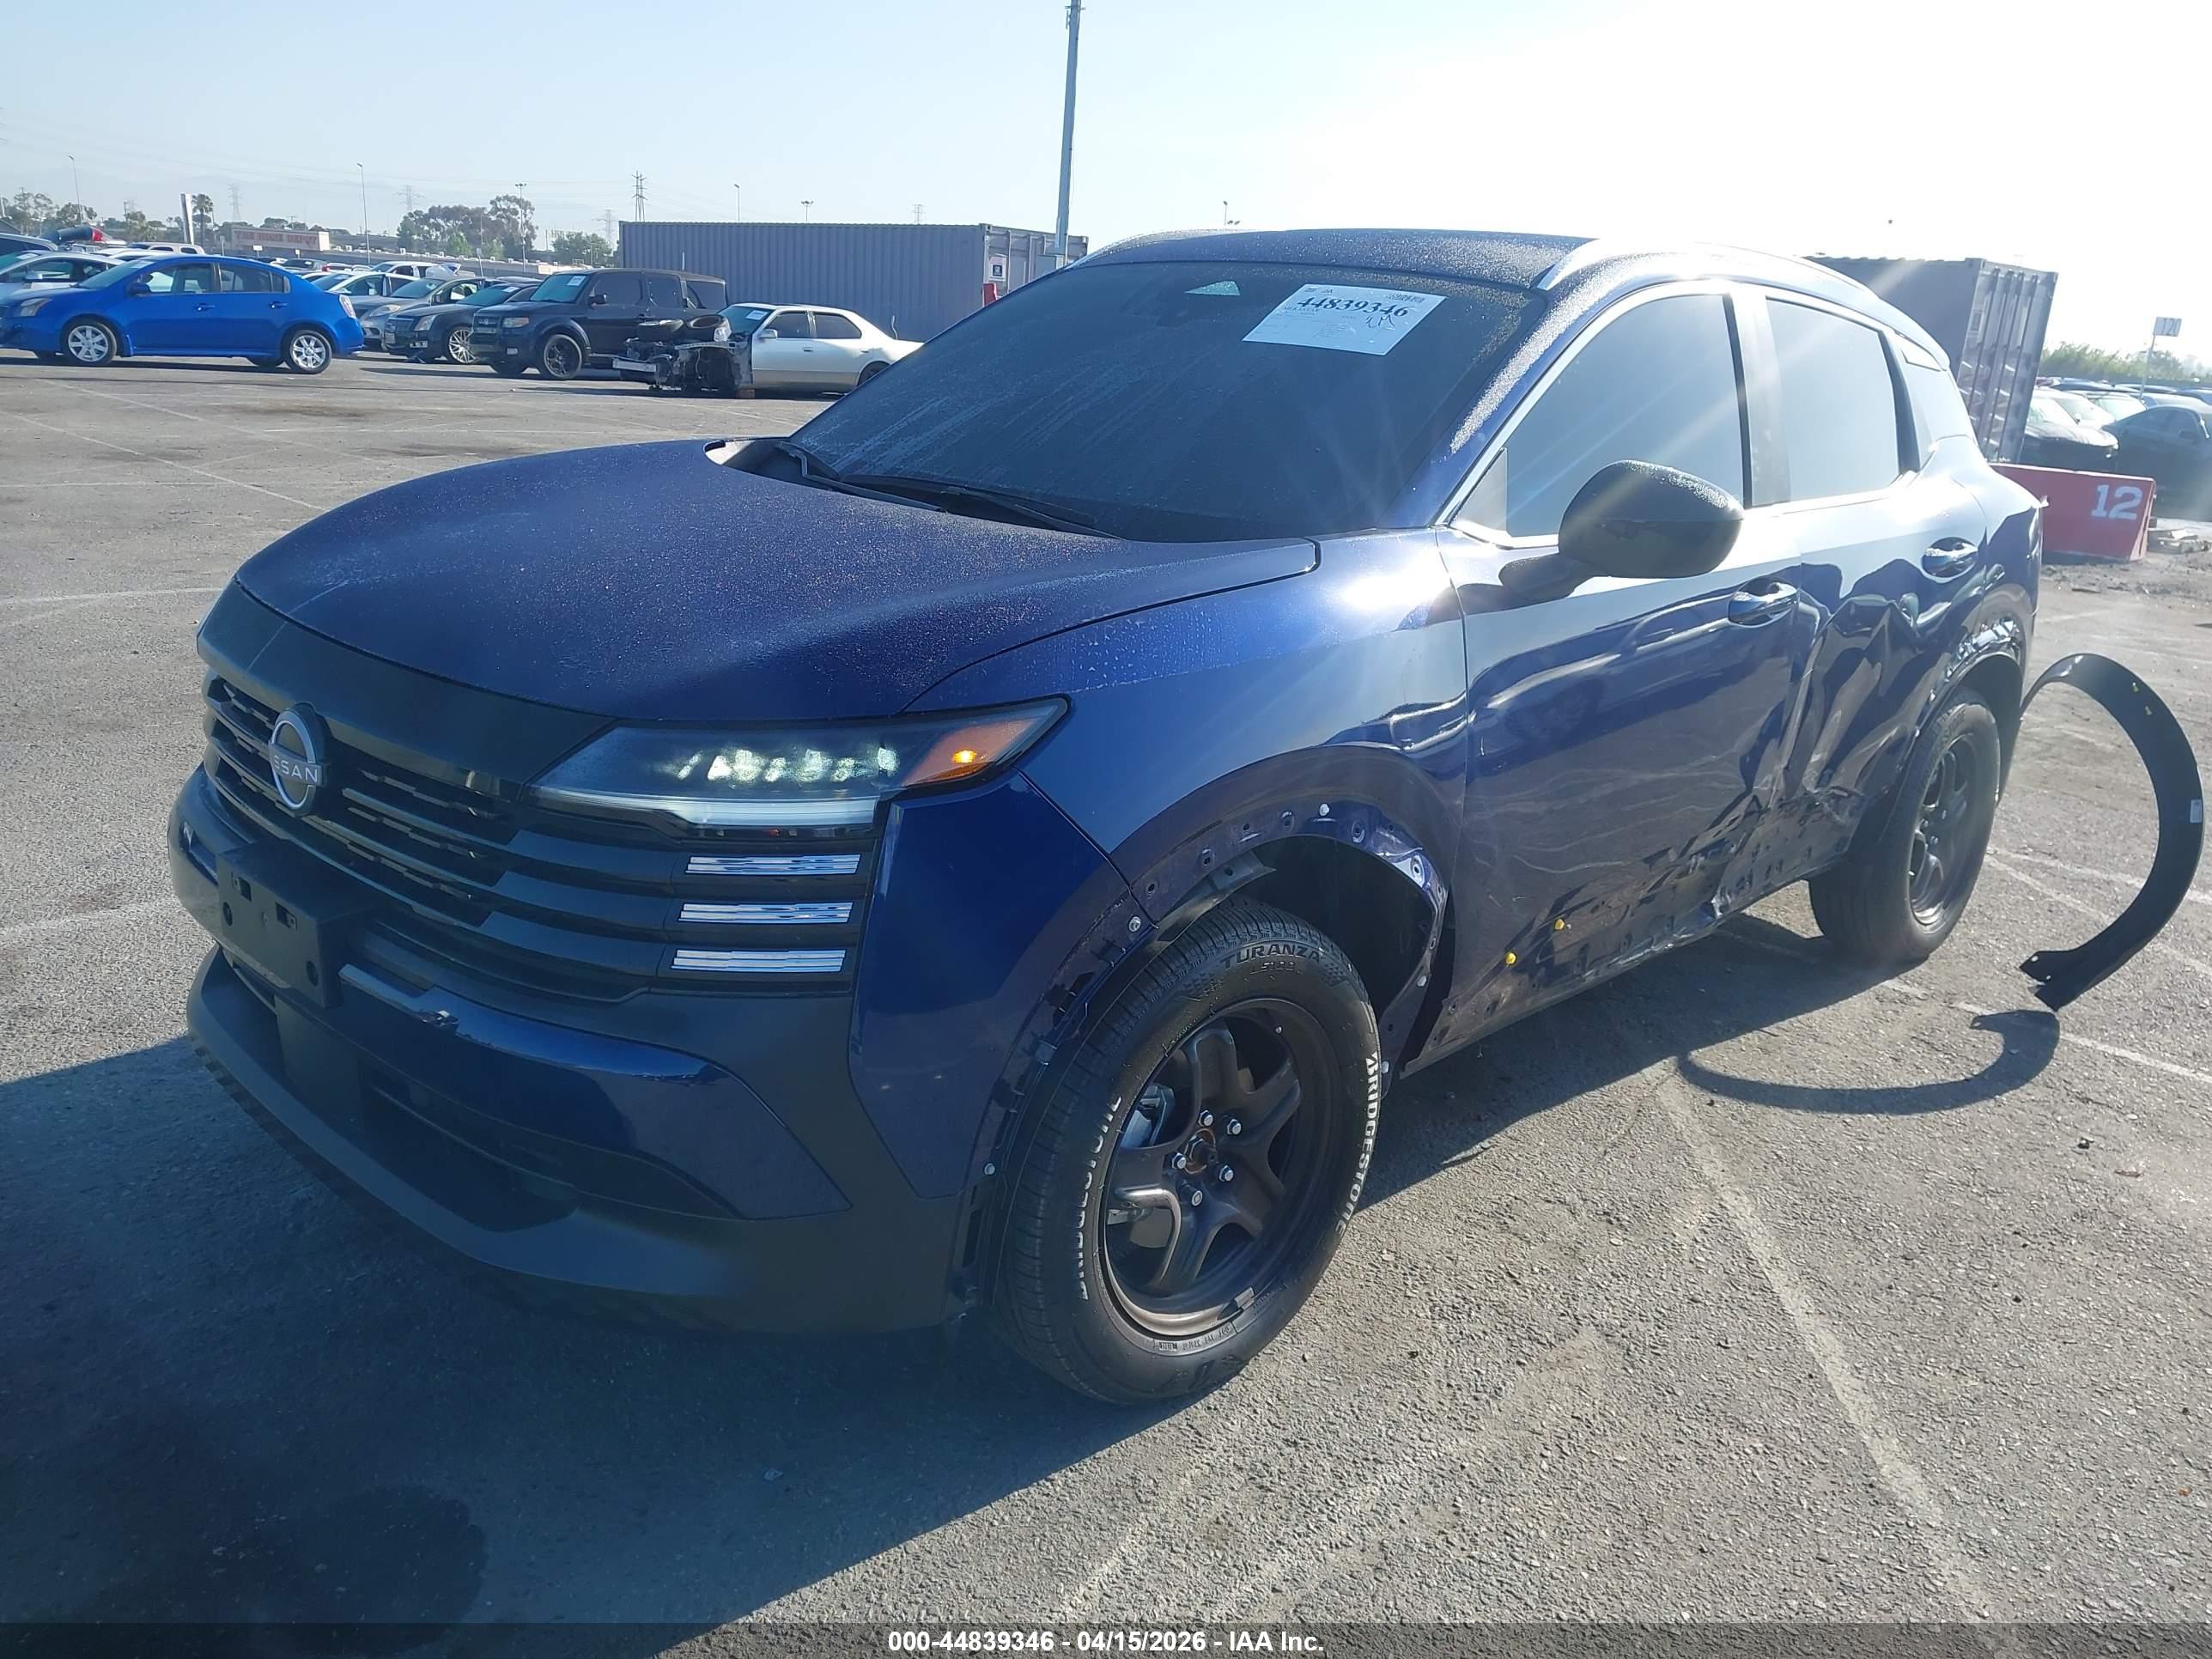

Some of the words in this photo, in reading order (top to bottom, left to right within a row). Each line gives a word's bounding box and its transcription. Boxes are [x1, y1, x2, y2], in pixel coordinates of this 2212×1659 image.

[1297, 296, 1412, 318] 44839346
[2091, 483, 2143, 520] 12
[1220, 943, 1324, 970] TURANZA
[1334, 1051, 1379, 1238] BRIDGESTONE
